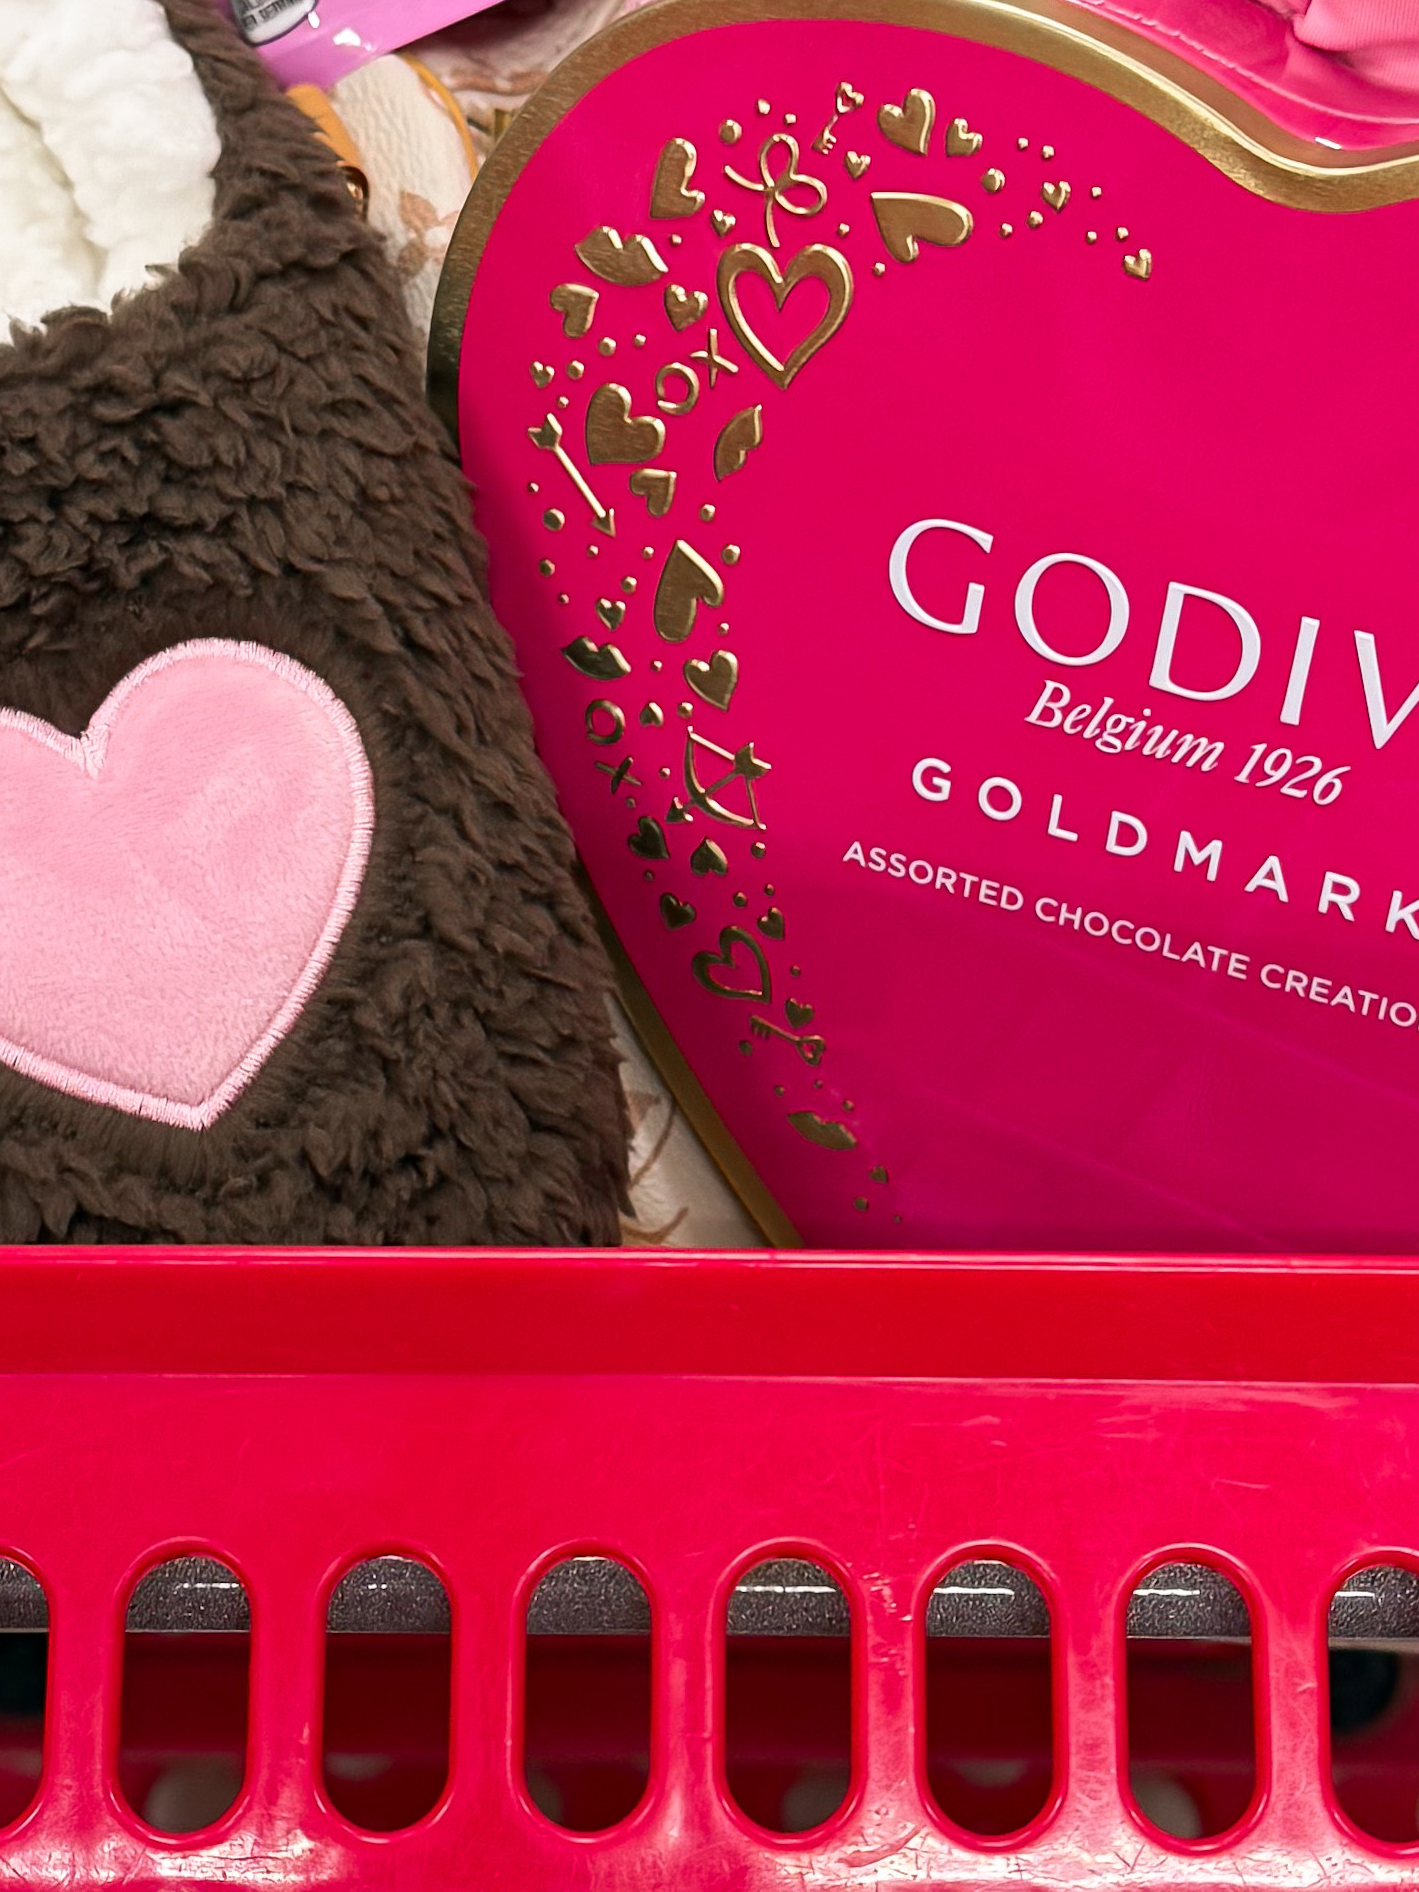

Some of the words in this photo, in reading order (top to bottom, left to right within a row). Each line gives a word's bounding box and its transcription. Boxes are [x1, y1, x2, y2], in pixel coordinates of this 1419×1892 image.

[1025, 680, 1225, 773] Belgium
[1234, 741, 1352, 806] 1926
[842, 841, 1025, 913] ASSORTED
[1035, 896, 1250, 979] CHOCOLATE
